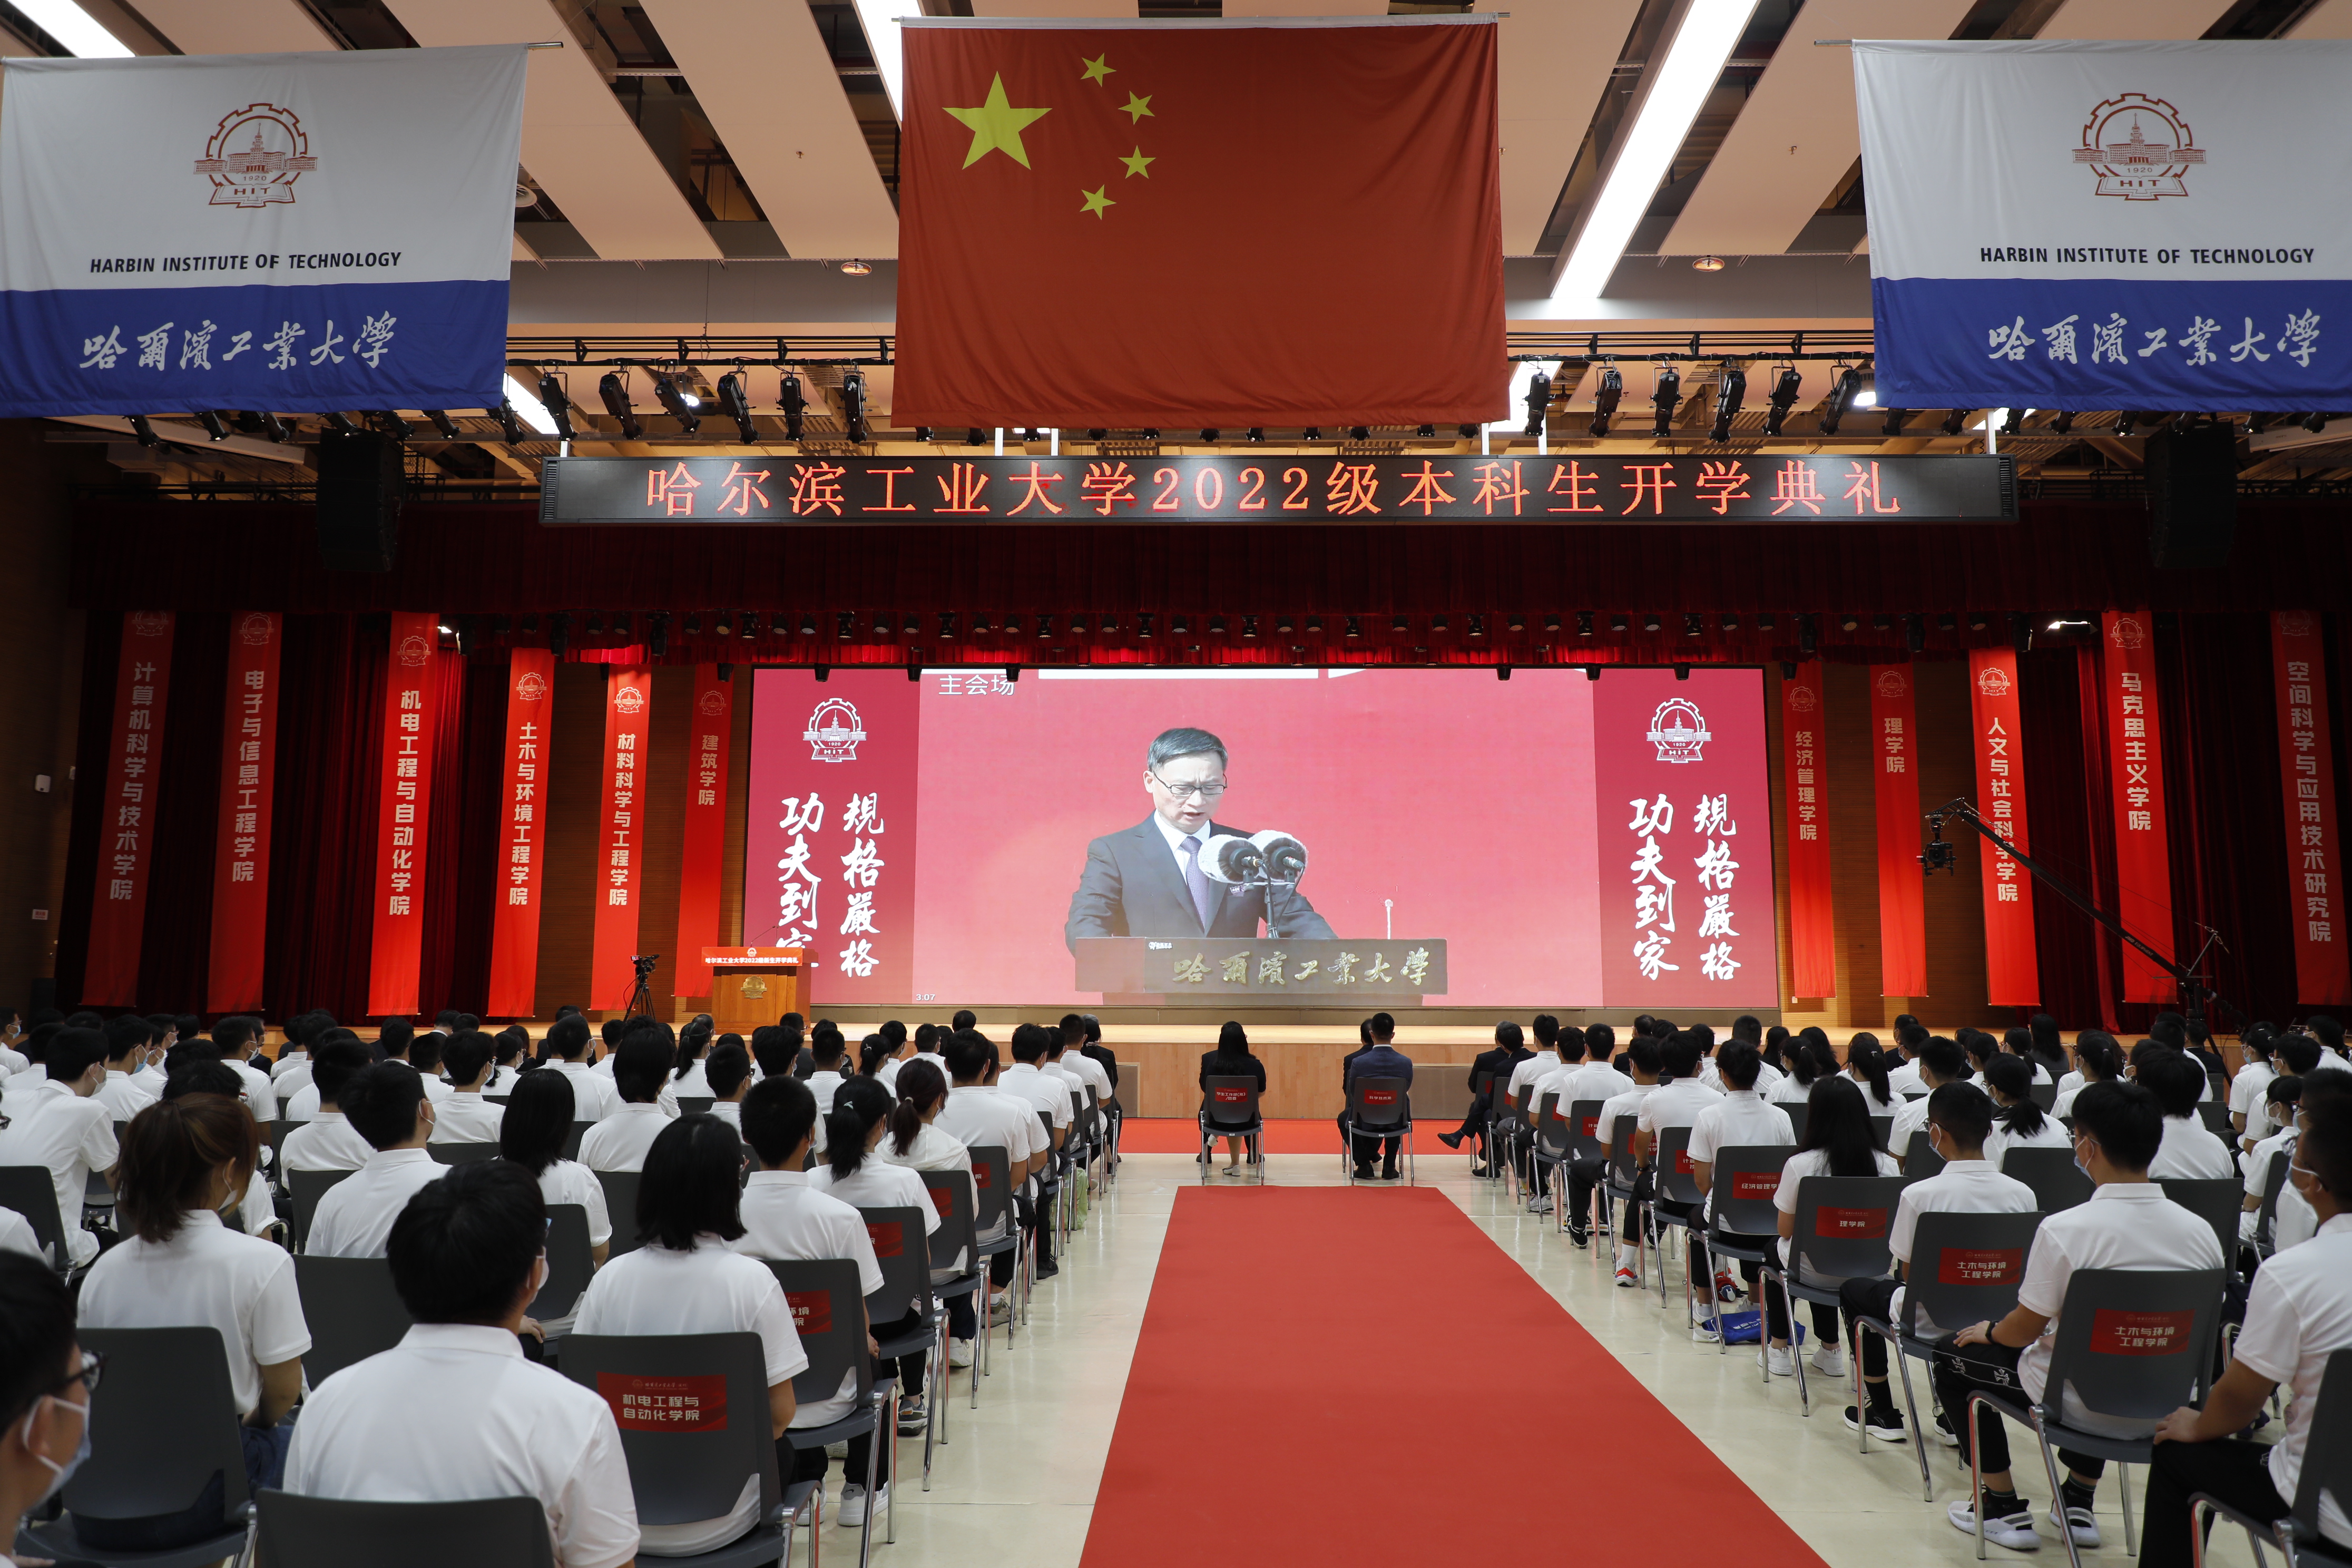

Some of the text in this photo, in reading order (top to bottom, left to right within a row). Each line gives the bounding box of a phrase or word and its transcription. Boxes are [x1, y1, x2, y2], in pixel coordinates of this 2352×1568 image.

[234, 187, 271, 196] HIT
[2120, 179, 2160, 188] HIT
[90, 252, 402, 273] HARBIN INSTITUTE OF TECHNOLOGY
[1980, 248, 2315, 264] HARBIN INSTITUTE OF TECHNOLOGY
[646, 460, 1901, 517] 哈尔滨工业大学2022级本科生开学典礼
[939, 674, 1016, 696] 主会场
[698, 734, 719, 806] 建筑学院
[1884, 718, 1905, 773] 理学院
[2121, 672, 2151, 831] 马克思主义学院
[110, 662, 156, 900] 计算机科学与技术学院
[232, 671, 264, 882] 电子与信息工程学院
[389, 690, 421, 915] 机电工程与自动化学院
[1795, 731, 1817, 841] 经济管理学院
[2287, 661, 2331, 942] 空间科学与应用技术研究院
[509, 722, 537, 906] 土木与环境工程学院
[609, 733, 636, 906] 材料科学与工程学院
[1629, 793, 1680, 981] 功夫到家
[2115, 1326, 2175, 1336] 土木与环境
[2120, 1337, 2168, 1347] 工程学院
[622, 1394, 699, 1407] 机电工程与
[623, 1408, 700, 1420] 自动化学院
